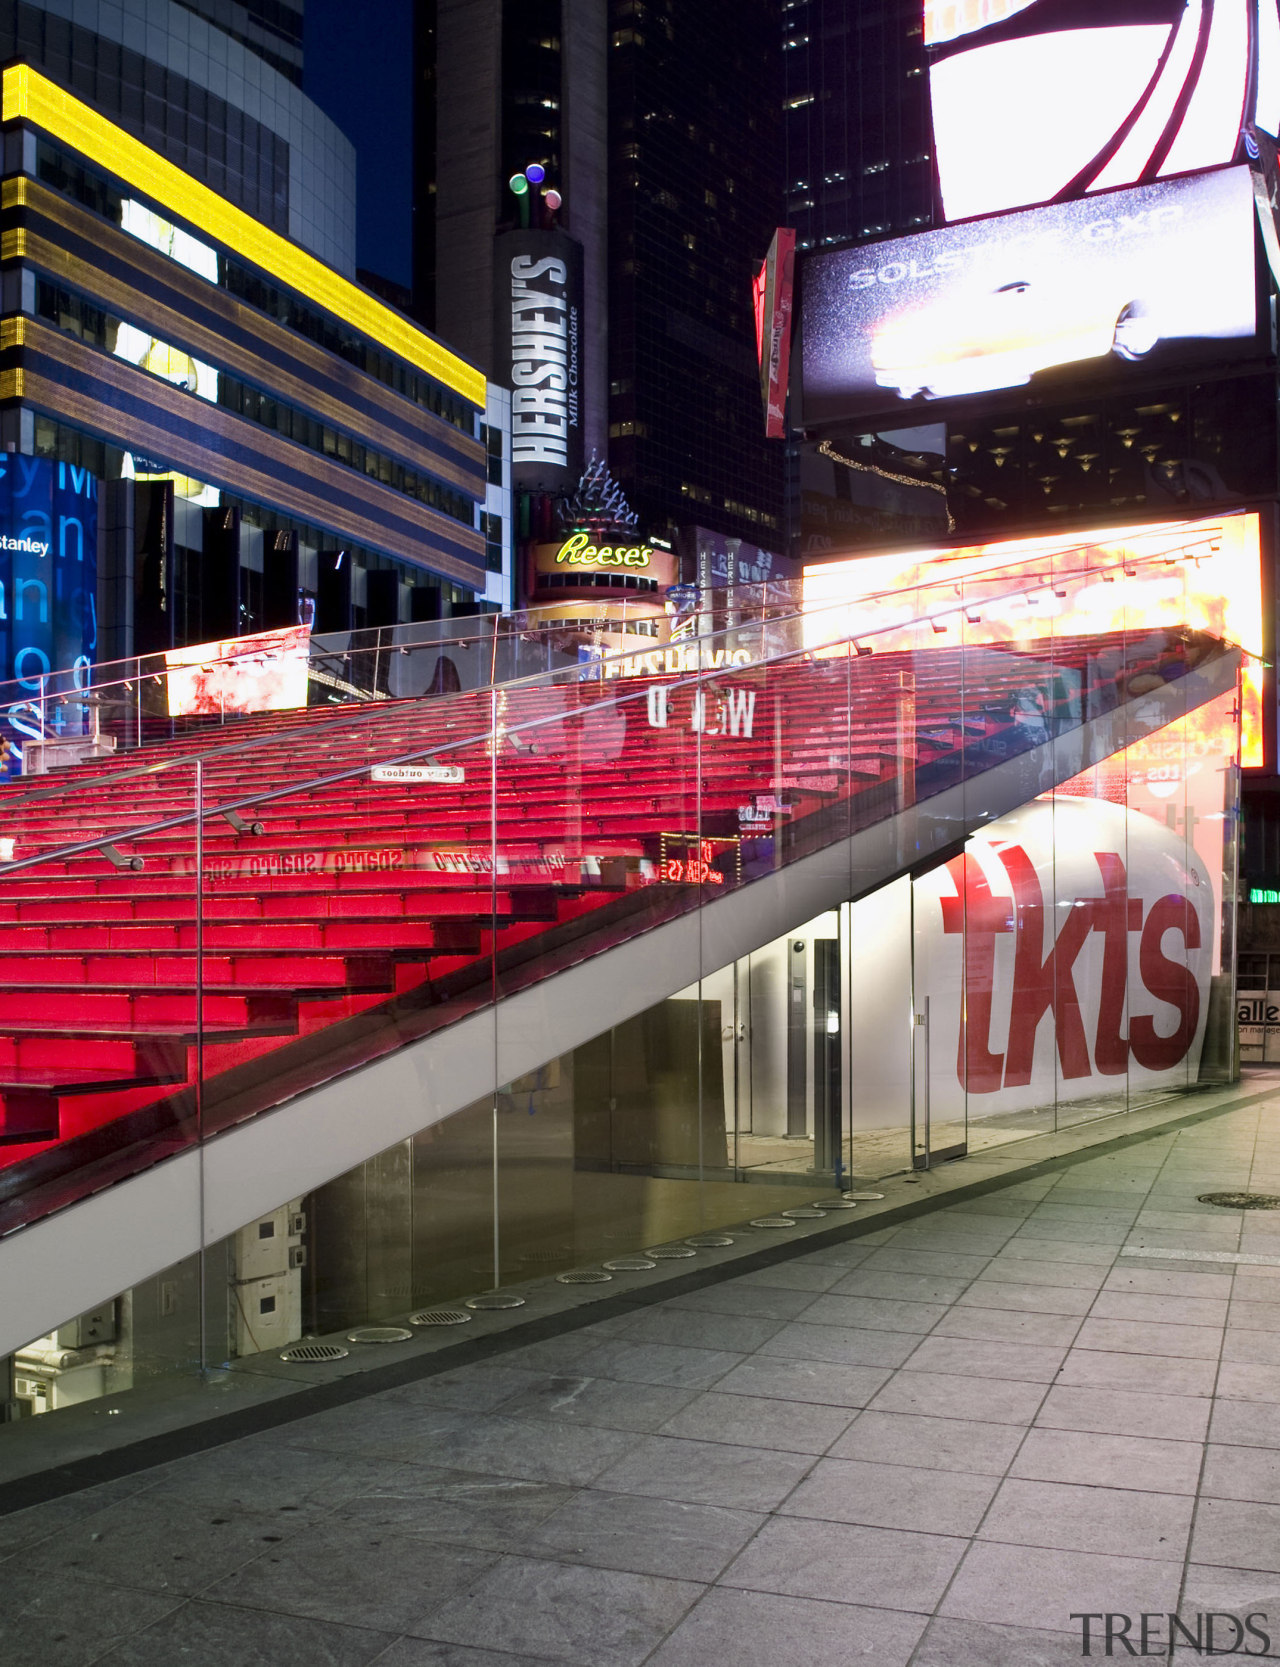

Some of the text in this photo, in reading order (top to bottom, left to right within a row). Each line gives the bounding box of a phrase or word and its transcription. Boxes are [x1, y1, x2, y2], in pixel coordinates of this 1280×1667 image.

[511, 254, 568, 466] HERSHEY'S
[569, 306, 578, 427] Milk Chocolate
[556, 533, 652, 568] Reese's
[939, 841, 1202, 1094] tkts
